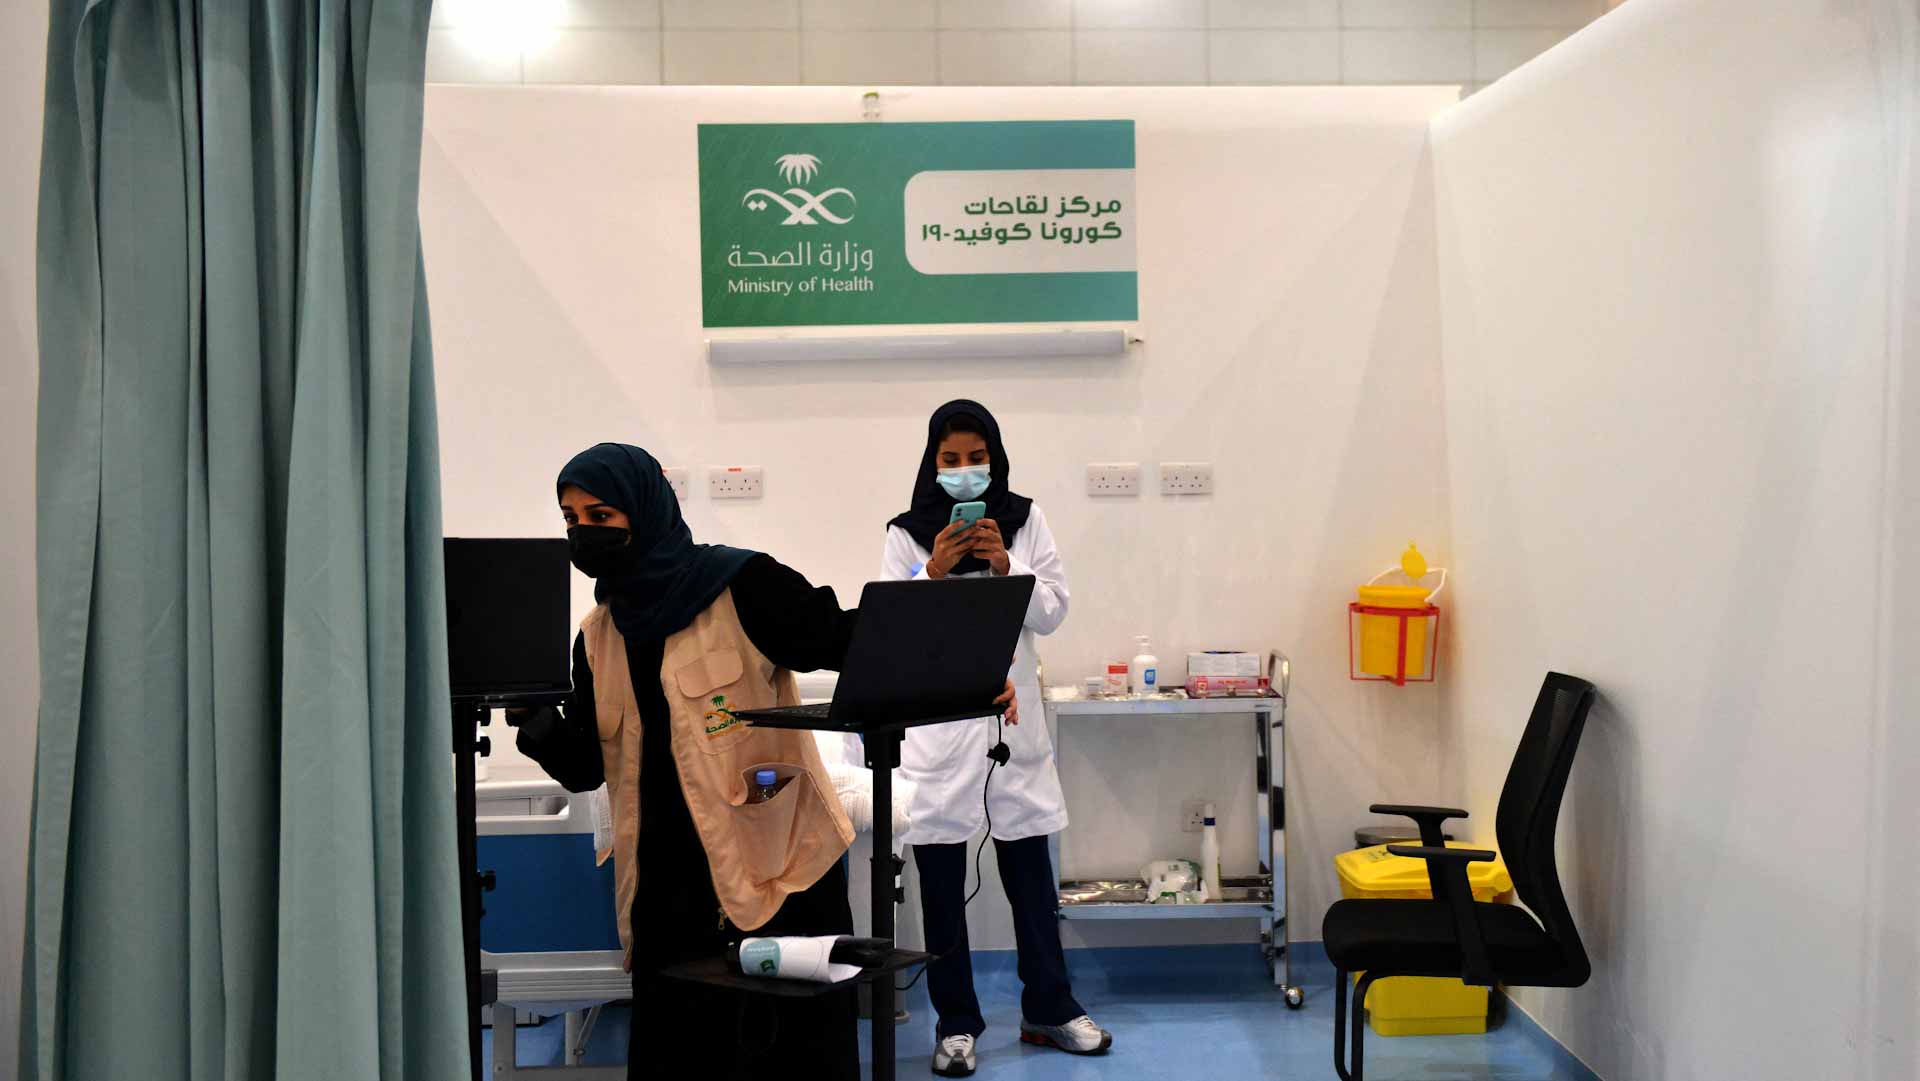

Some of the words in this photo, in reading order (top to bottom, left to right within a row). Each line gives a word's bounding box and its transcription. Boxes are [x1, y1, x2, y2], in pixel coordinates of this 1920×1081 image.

[964, 194, 1048, 215] لقاحات
[1055, 195, 1122, 218] مركز
[1040, 221, 1122, 244] كورونا
[727, 241, 811, 267] الصحة
[819, 240, 873, 272] وزارة
[728, 277, 794, 296] Ministry
[798, 276, 818, 292] of
[822, 275, 874, 292] Health
